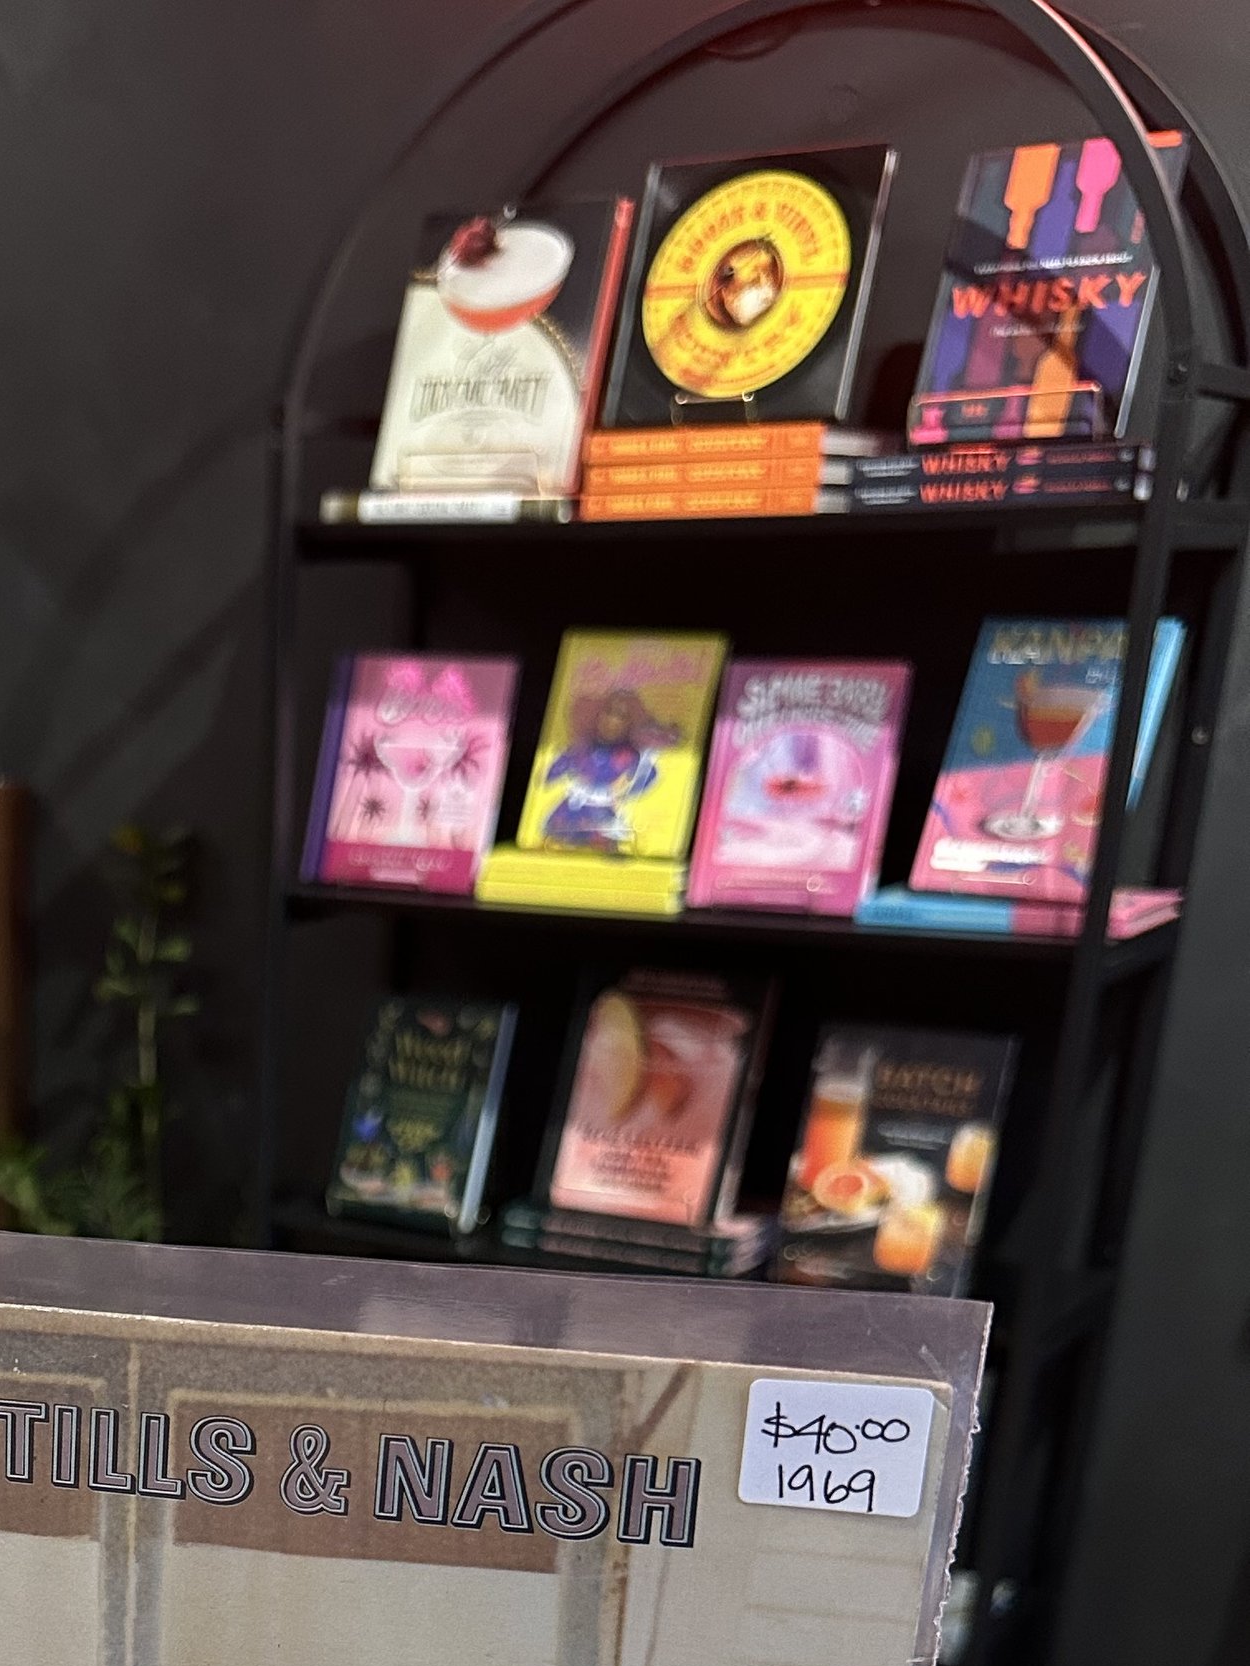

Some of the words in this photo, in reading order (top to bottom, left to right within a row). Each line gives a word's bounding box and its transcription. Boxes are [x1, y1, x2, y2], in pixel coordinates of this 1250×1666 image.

[952, 271, 1147, 319] WHISKY
[921, 452, 1013, 477] WHISKY
[919, 480, 1008, 504] WHISKY
[280, 1424, 350, 1516] &
[374, 1433, 703, 1548] NASH
[778, 1464, 876, 1513] 1969
